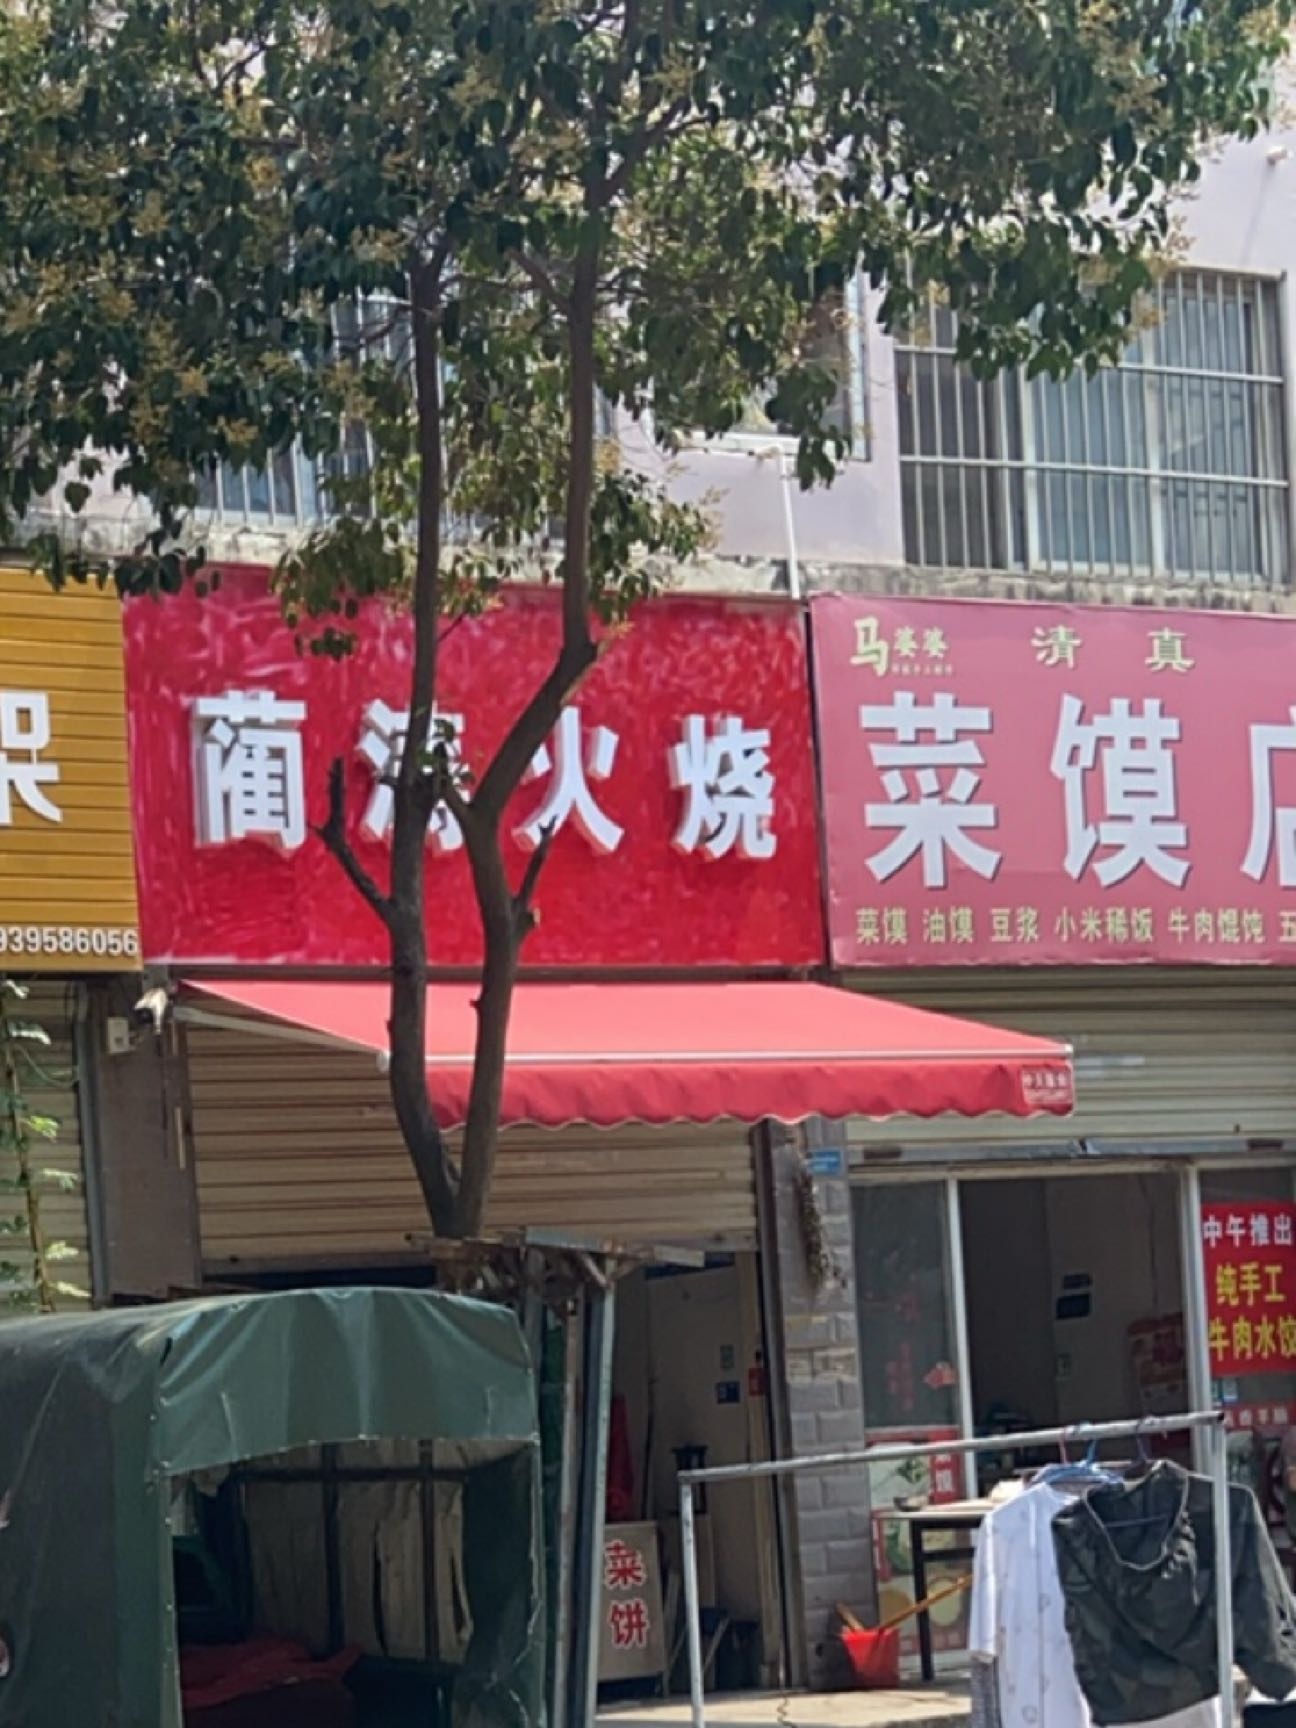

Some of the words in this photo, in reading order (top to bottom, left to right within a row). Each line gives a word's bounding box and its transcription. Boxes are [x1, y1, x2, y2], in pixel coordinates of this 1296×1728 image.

[1030, 624, 1195, 673] 清真
[990, 906, 1039, 944] 豆浆
[1054, 906, 1154, 944] 小米稀饭
[1167, 906, 1266, 944] 牛肉馄饨
[1204, 1213, 1292, 1249] 中午推出
[1215, 1262, 1285, 1307] 纯手工
[605, 1540, 649, 1650] 菜饼
